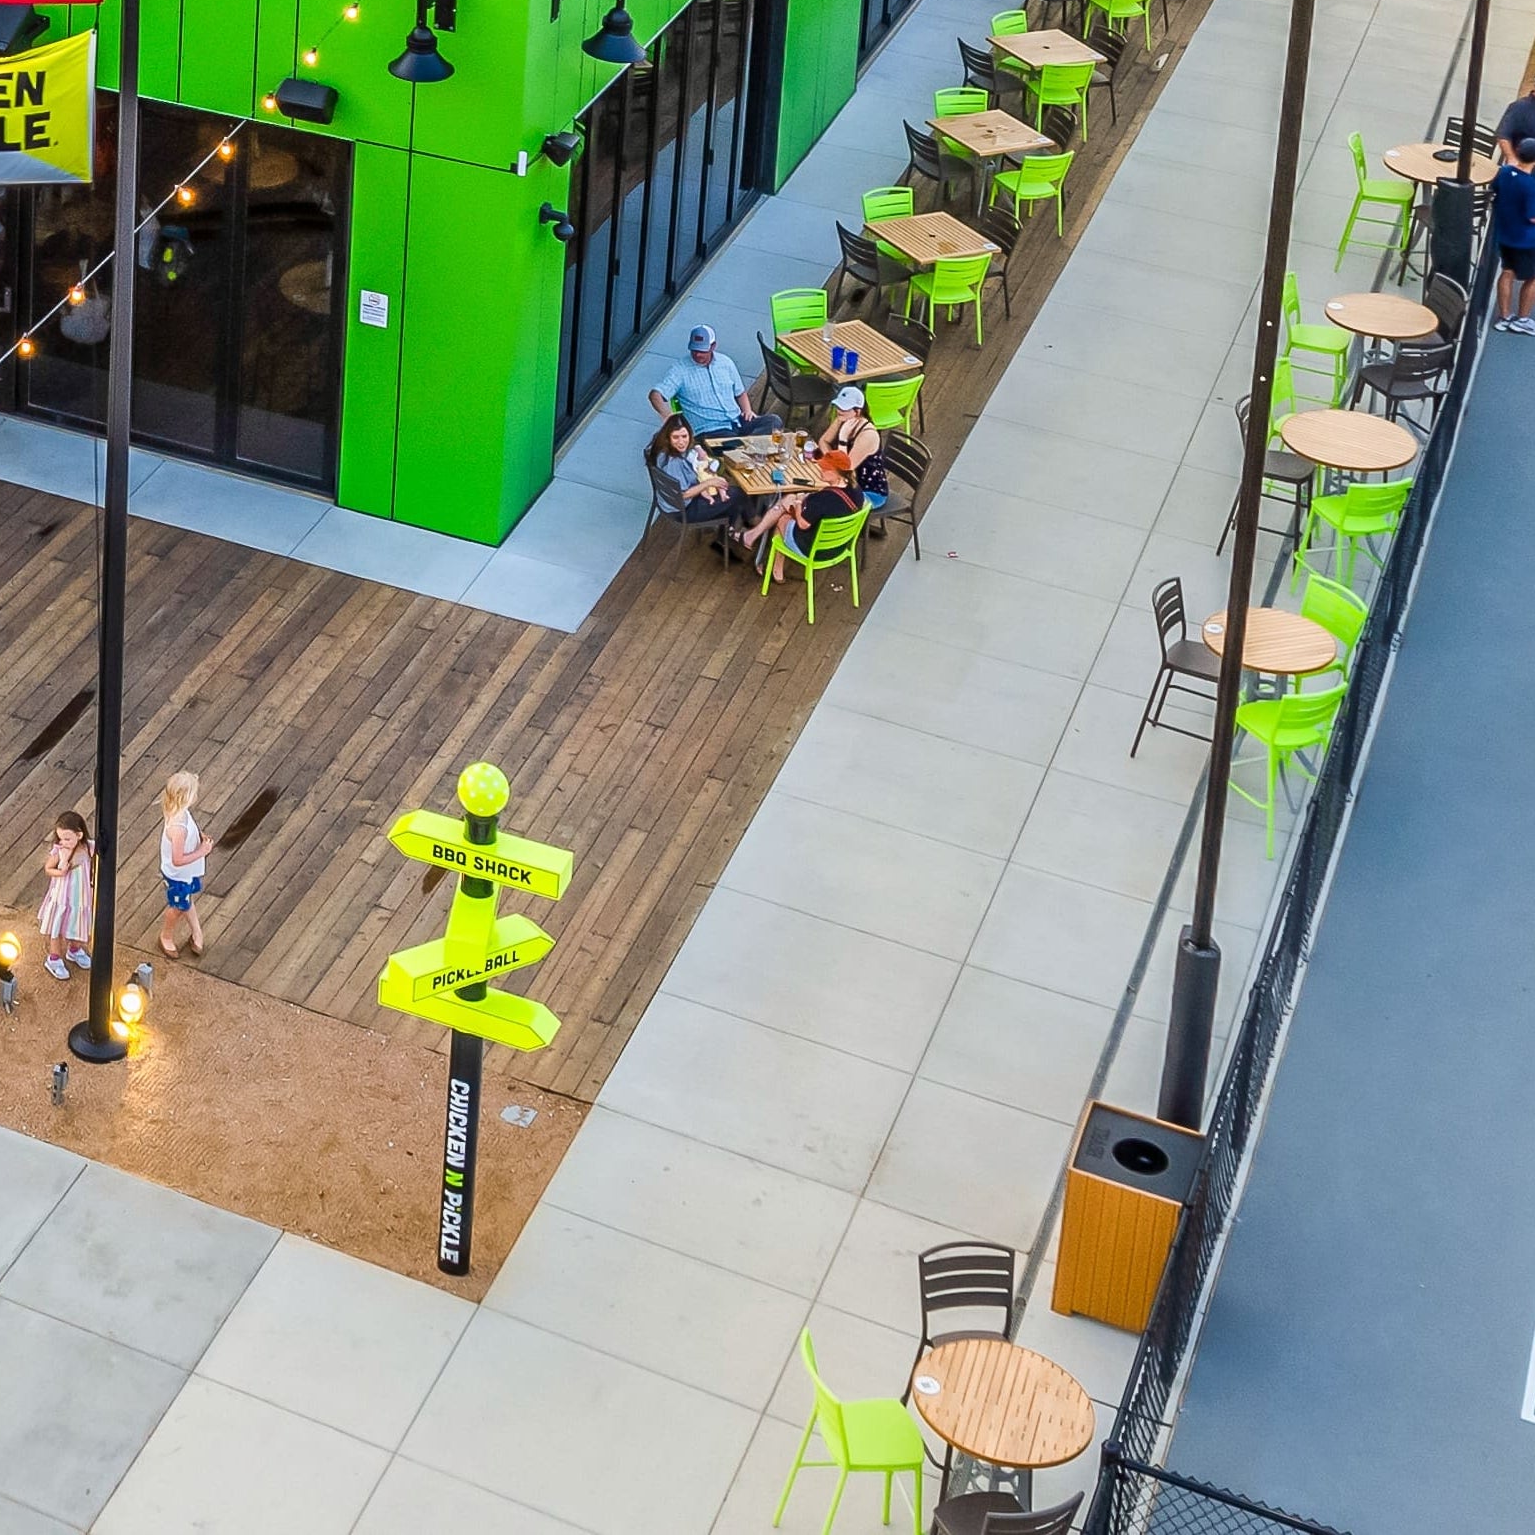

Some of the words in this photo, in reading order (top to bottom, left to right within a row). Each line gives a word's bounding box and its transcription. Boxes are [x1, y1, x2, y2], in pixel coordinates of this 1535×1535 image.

[433, 844, 467, 866] BBQ
[473, 856, 532, 885] SHACK
[446, 1078, 470, 1169] CHICKEN
[445, 1168, 464, 1187] N
